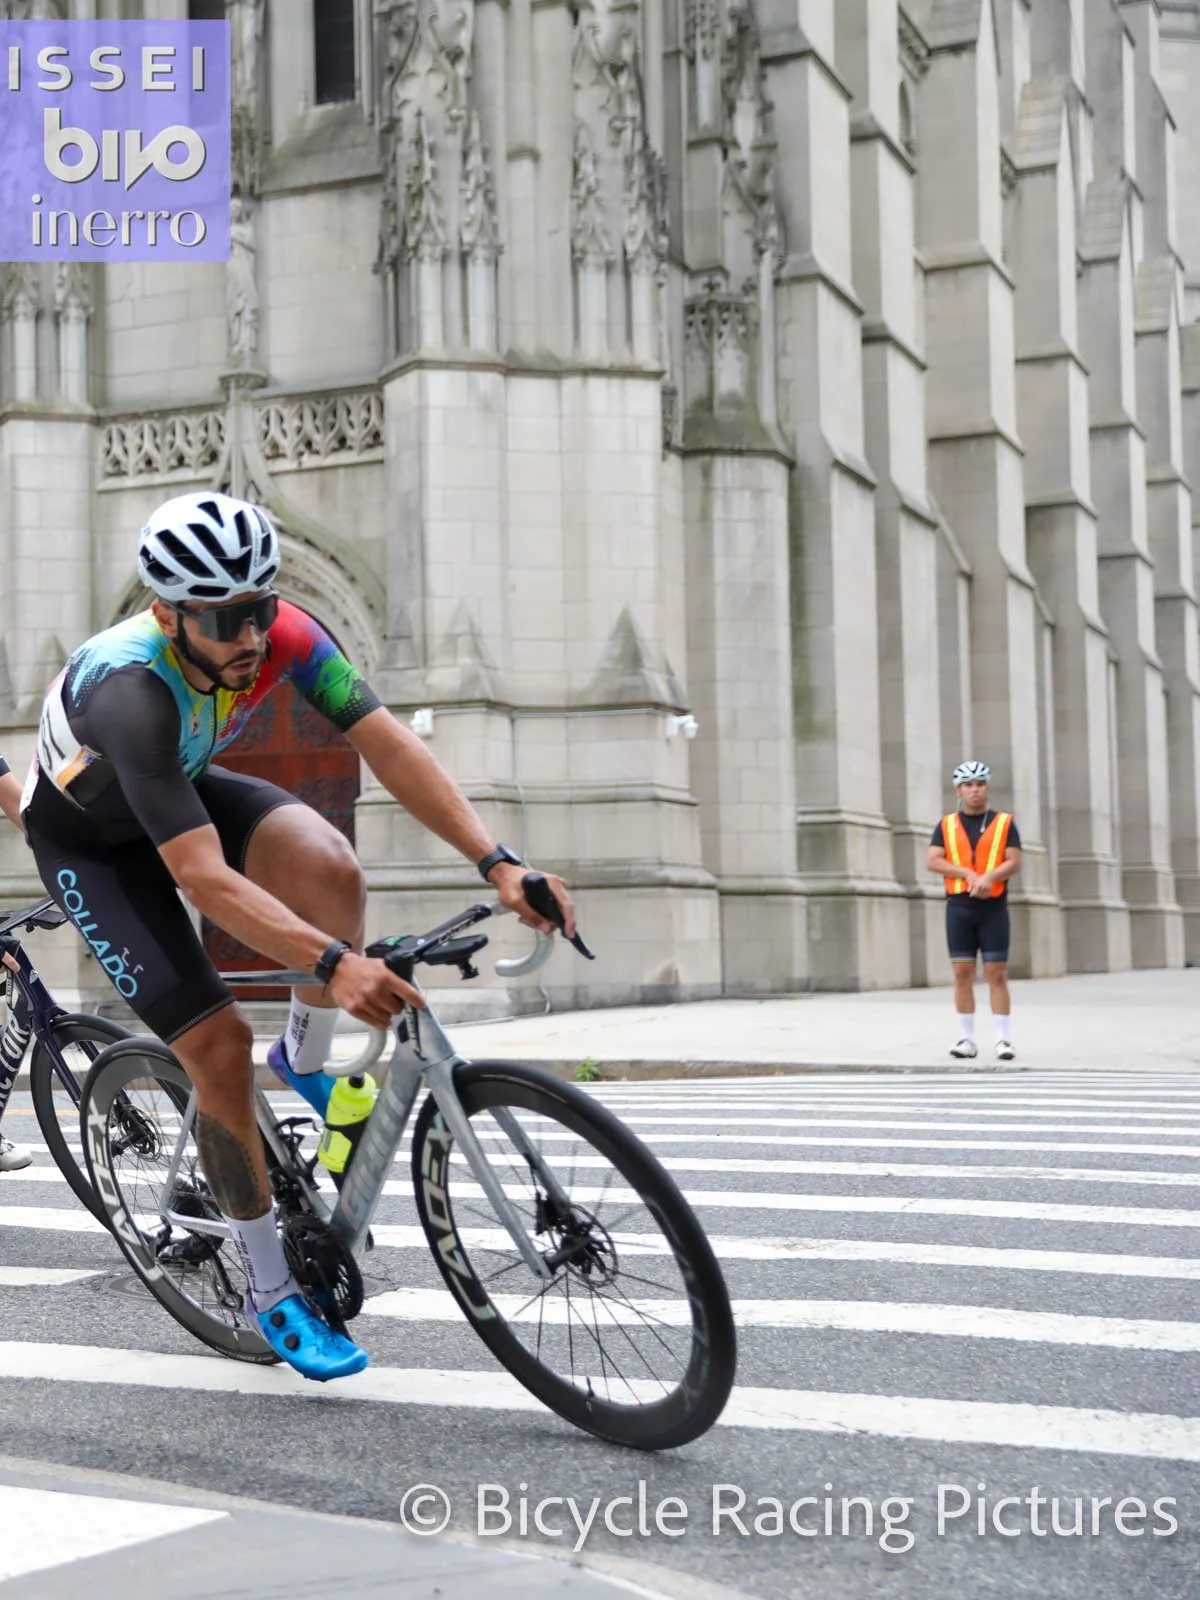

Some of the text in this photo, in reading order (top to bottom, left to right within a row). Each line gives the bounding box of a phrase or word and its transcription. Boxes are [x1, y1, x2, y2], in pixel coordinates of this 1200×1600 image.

[57, 869, 138, 998] COLLADO
[88, 1095, 163, 1281] CADEX
[423, 1111, 497, 1321] CADEX
